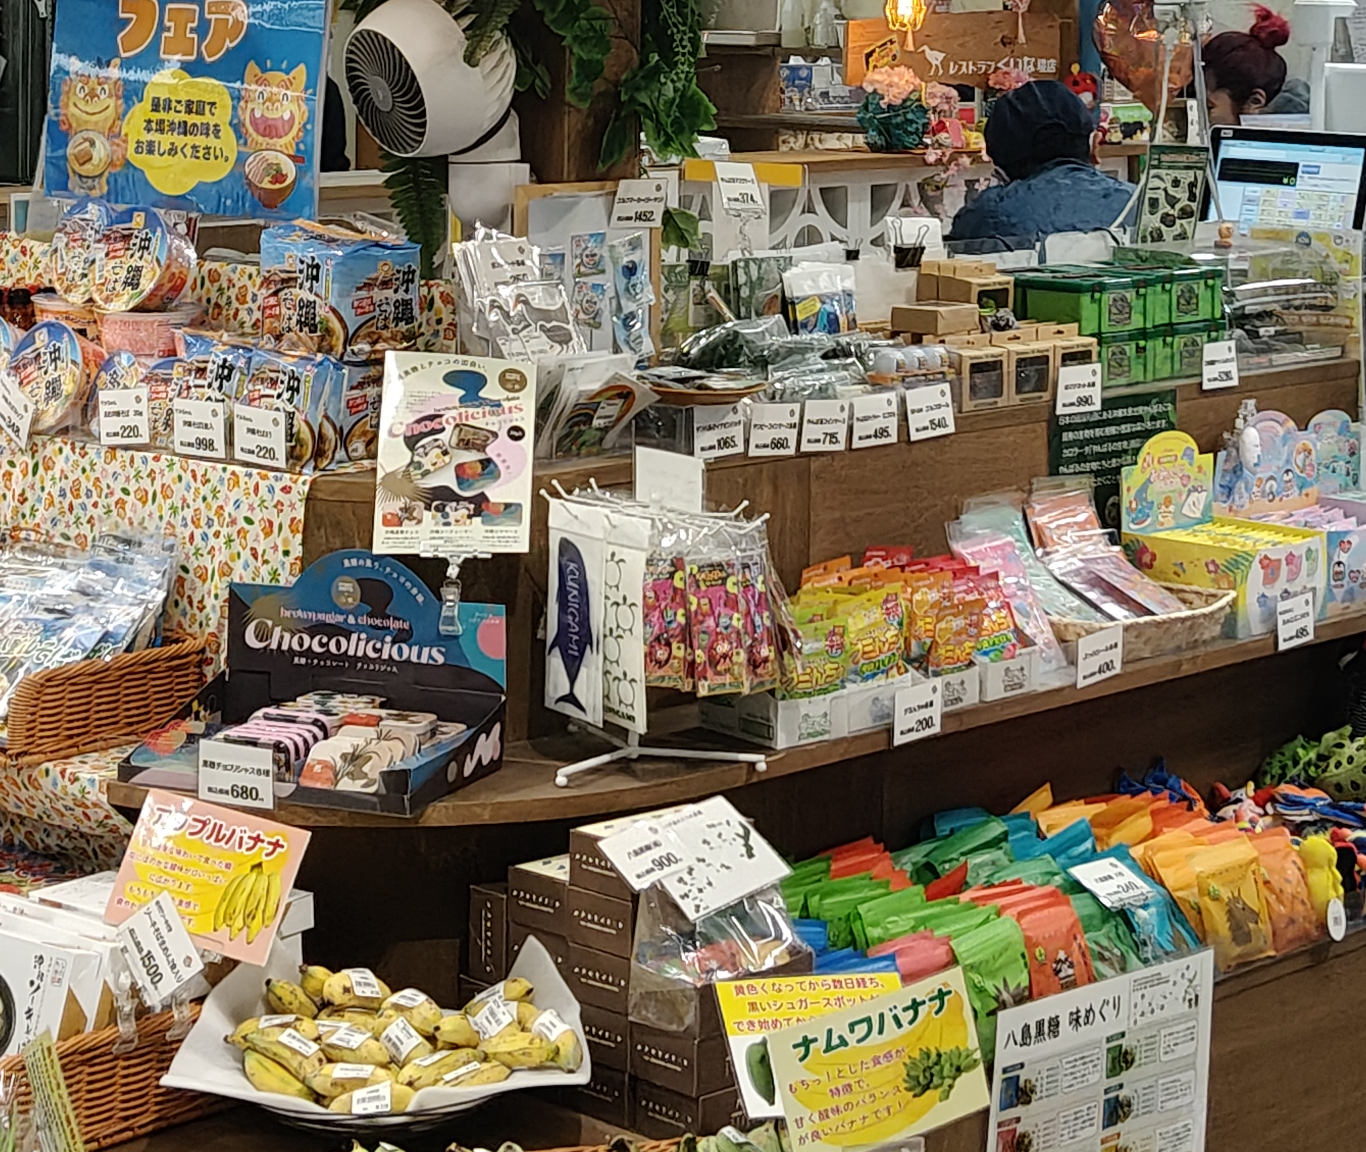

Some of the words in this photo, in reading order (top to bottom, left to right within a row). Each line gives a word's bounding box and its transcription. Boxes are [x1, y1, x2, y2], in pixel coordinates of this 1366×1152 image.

[142, 118, 223, 139] 本場沖縄の味を
[149, 95, 218, 118] 是非ご家庭で
[133, 138, 231, 164] お楽しみください。
[564, 559, 591, 658] KUNIGAMI
[244, 617, 447, 667] Chocolicious
[791, 983, 954, 1064] ナムワバナナ
[1003, 1014, 1061, 1049] 八島黒糖
[1068, 993, 1123, 1033] 味めぐり
